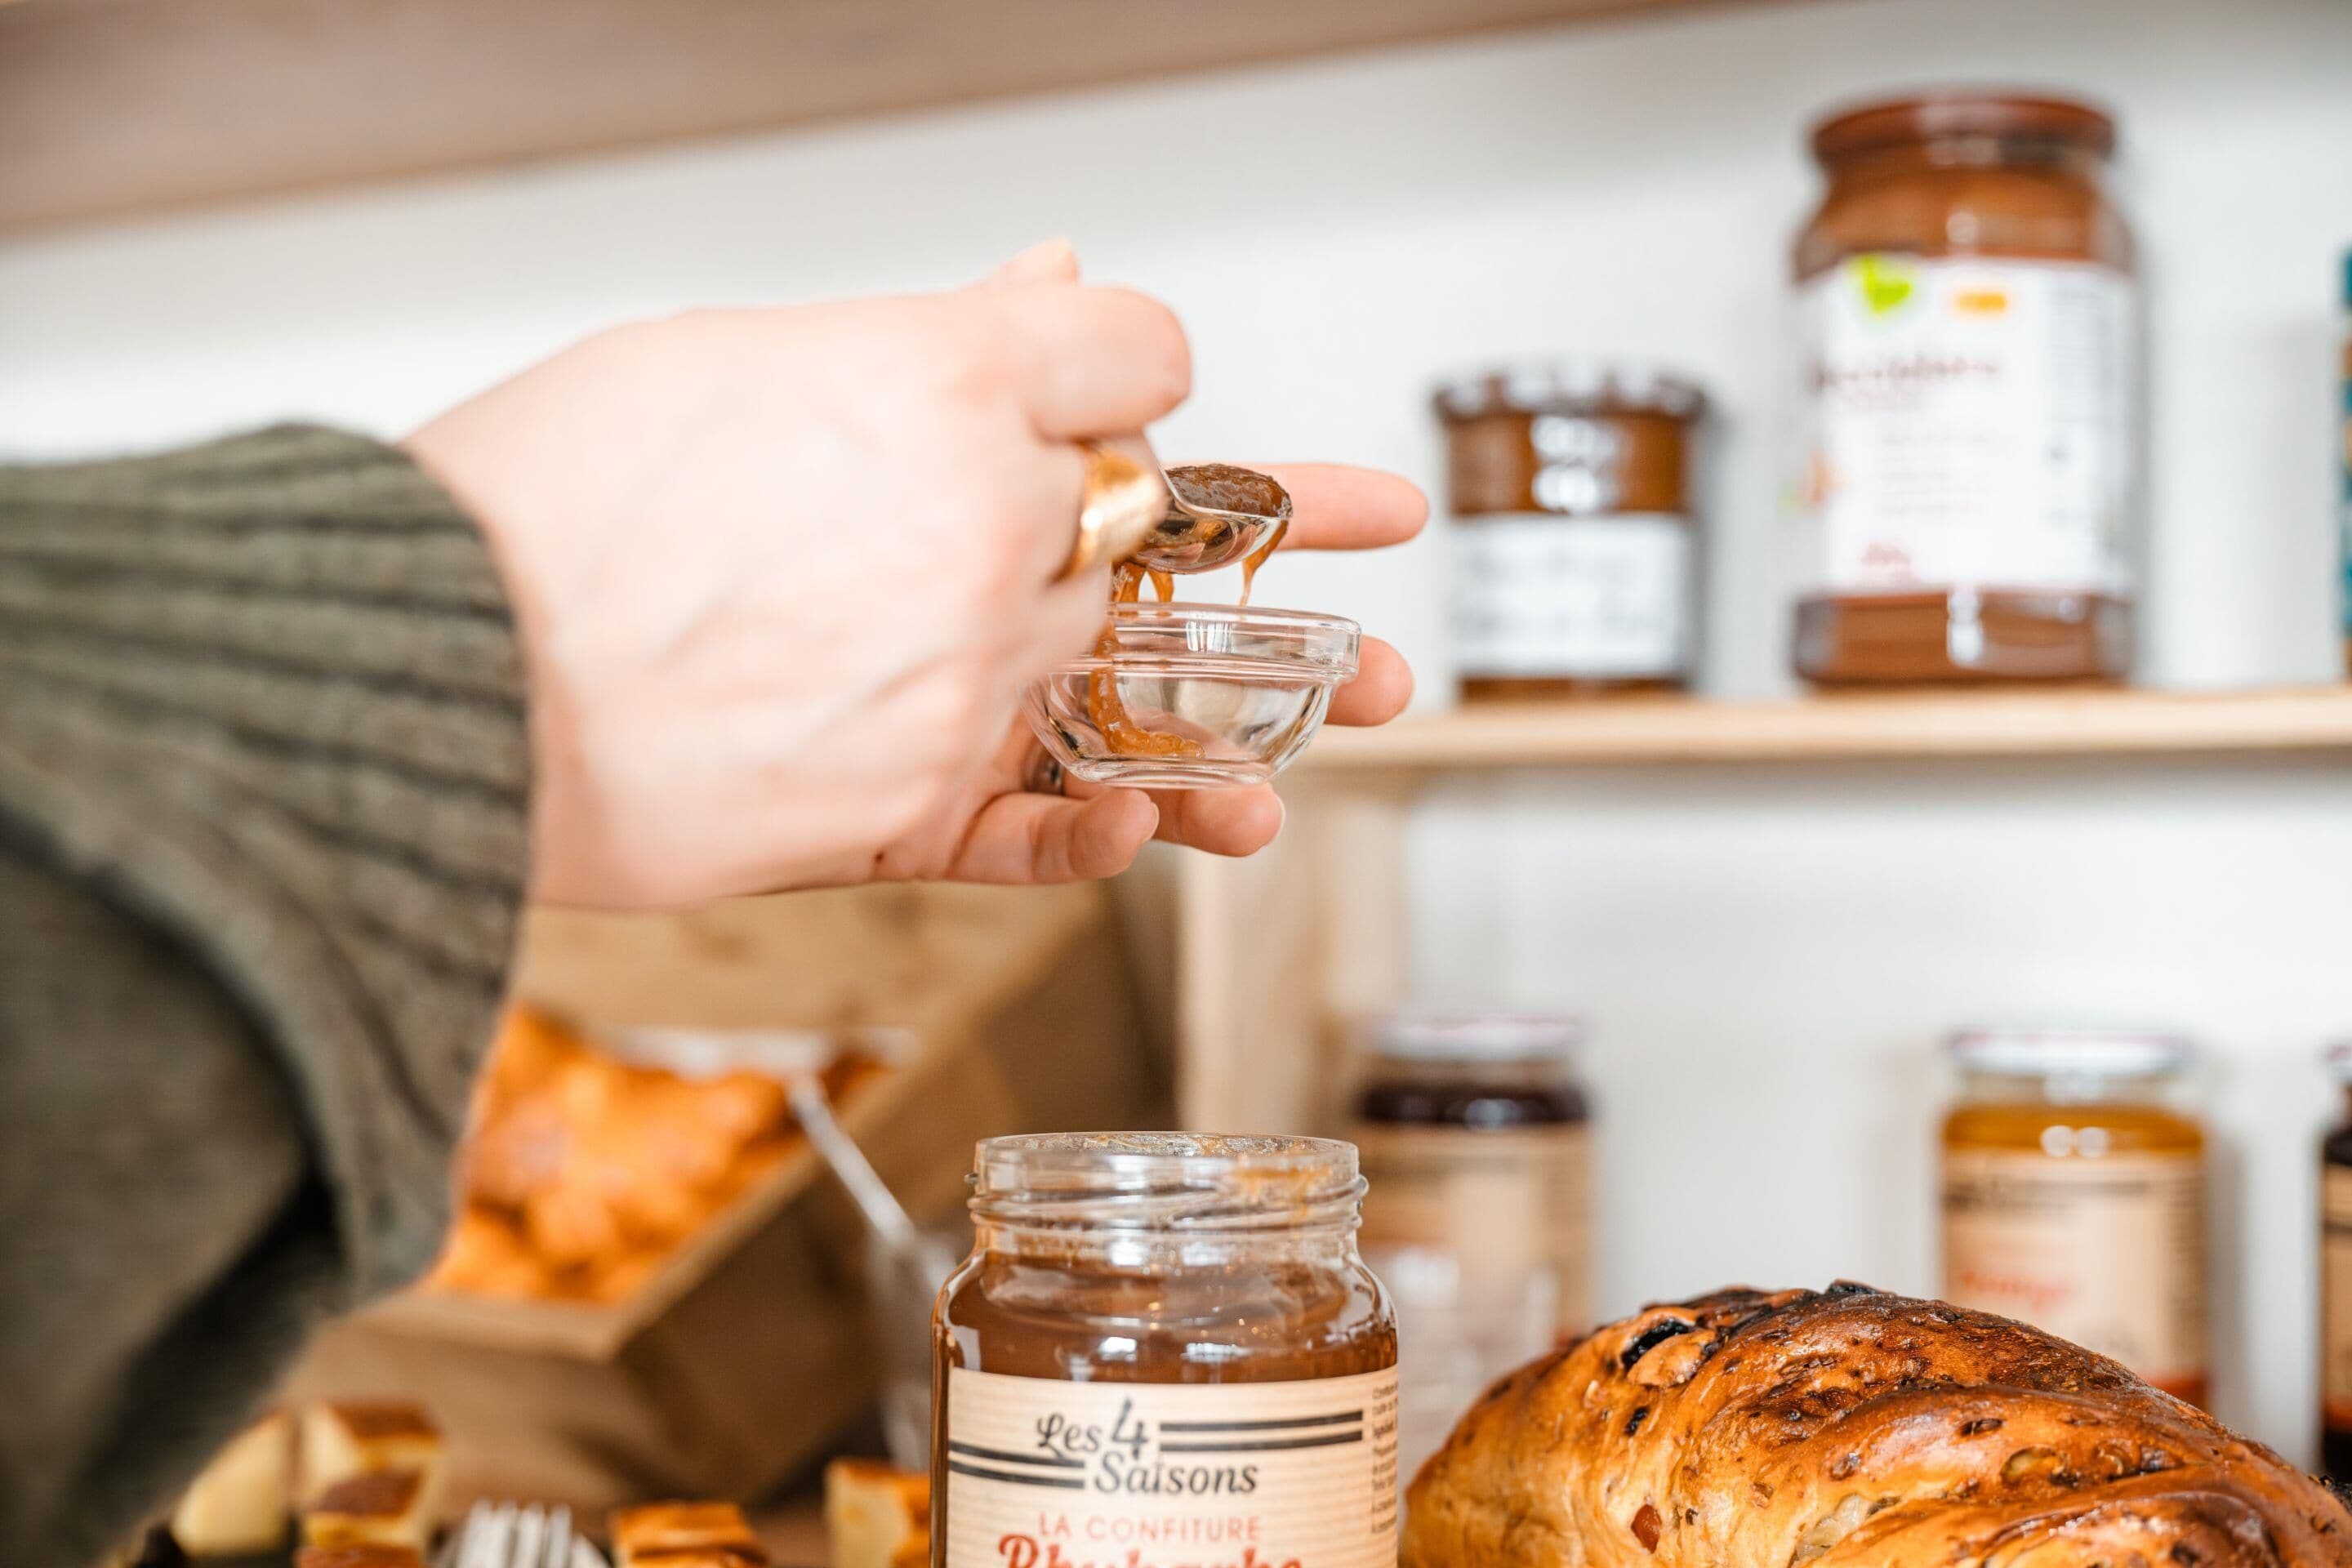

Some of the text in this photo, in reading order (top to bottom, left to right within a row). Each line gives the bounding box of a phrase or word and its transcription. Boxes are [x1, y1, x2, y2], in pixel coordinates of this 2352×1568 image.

[1036, 1396, 1148, 1460] Les 4
[1094, 1450, 1258, 1494] Saisons
[1039, 1512, 1260, 1542] LA CONFITURE
